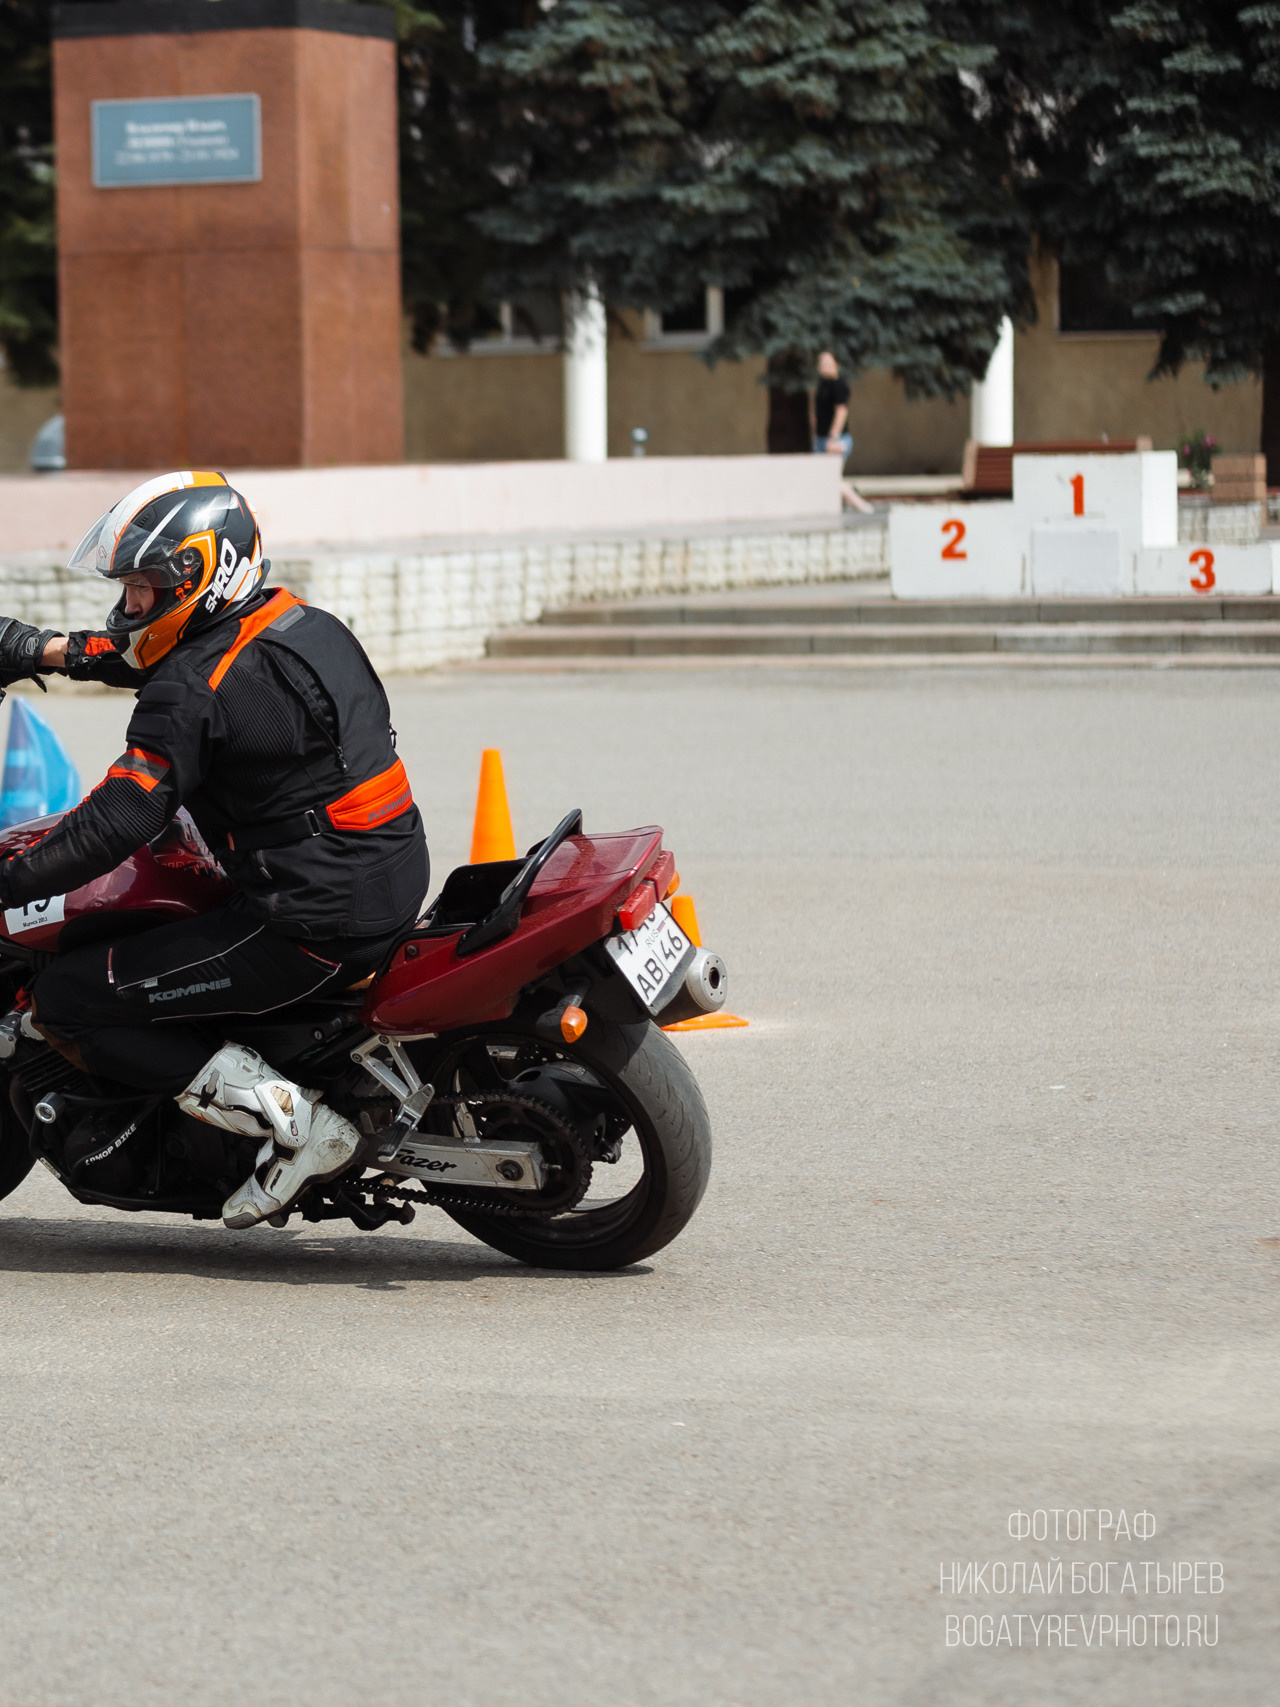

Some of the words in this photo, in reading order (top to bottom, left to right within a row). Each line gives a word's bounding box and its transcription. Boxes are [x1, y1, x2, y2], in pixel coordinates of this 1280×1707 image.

[1069, 472, 1085, 517] 1
[940, 519, 968, 561] 2
[205, 538, 237, 613] SHIRO
[1189, 549, 1217, 592] 3
[660, 928, 683, 960] 46
[148, 977, 232, 1004] KOMINE
[636, 957, 664, 1000] AB
[114, 1122, 137, 1148] BIKE
